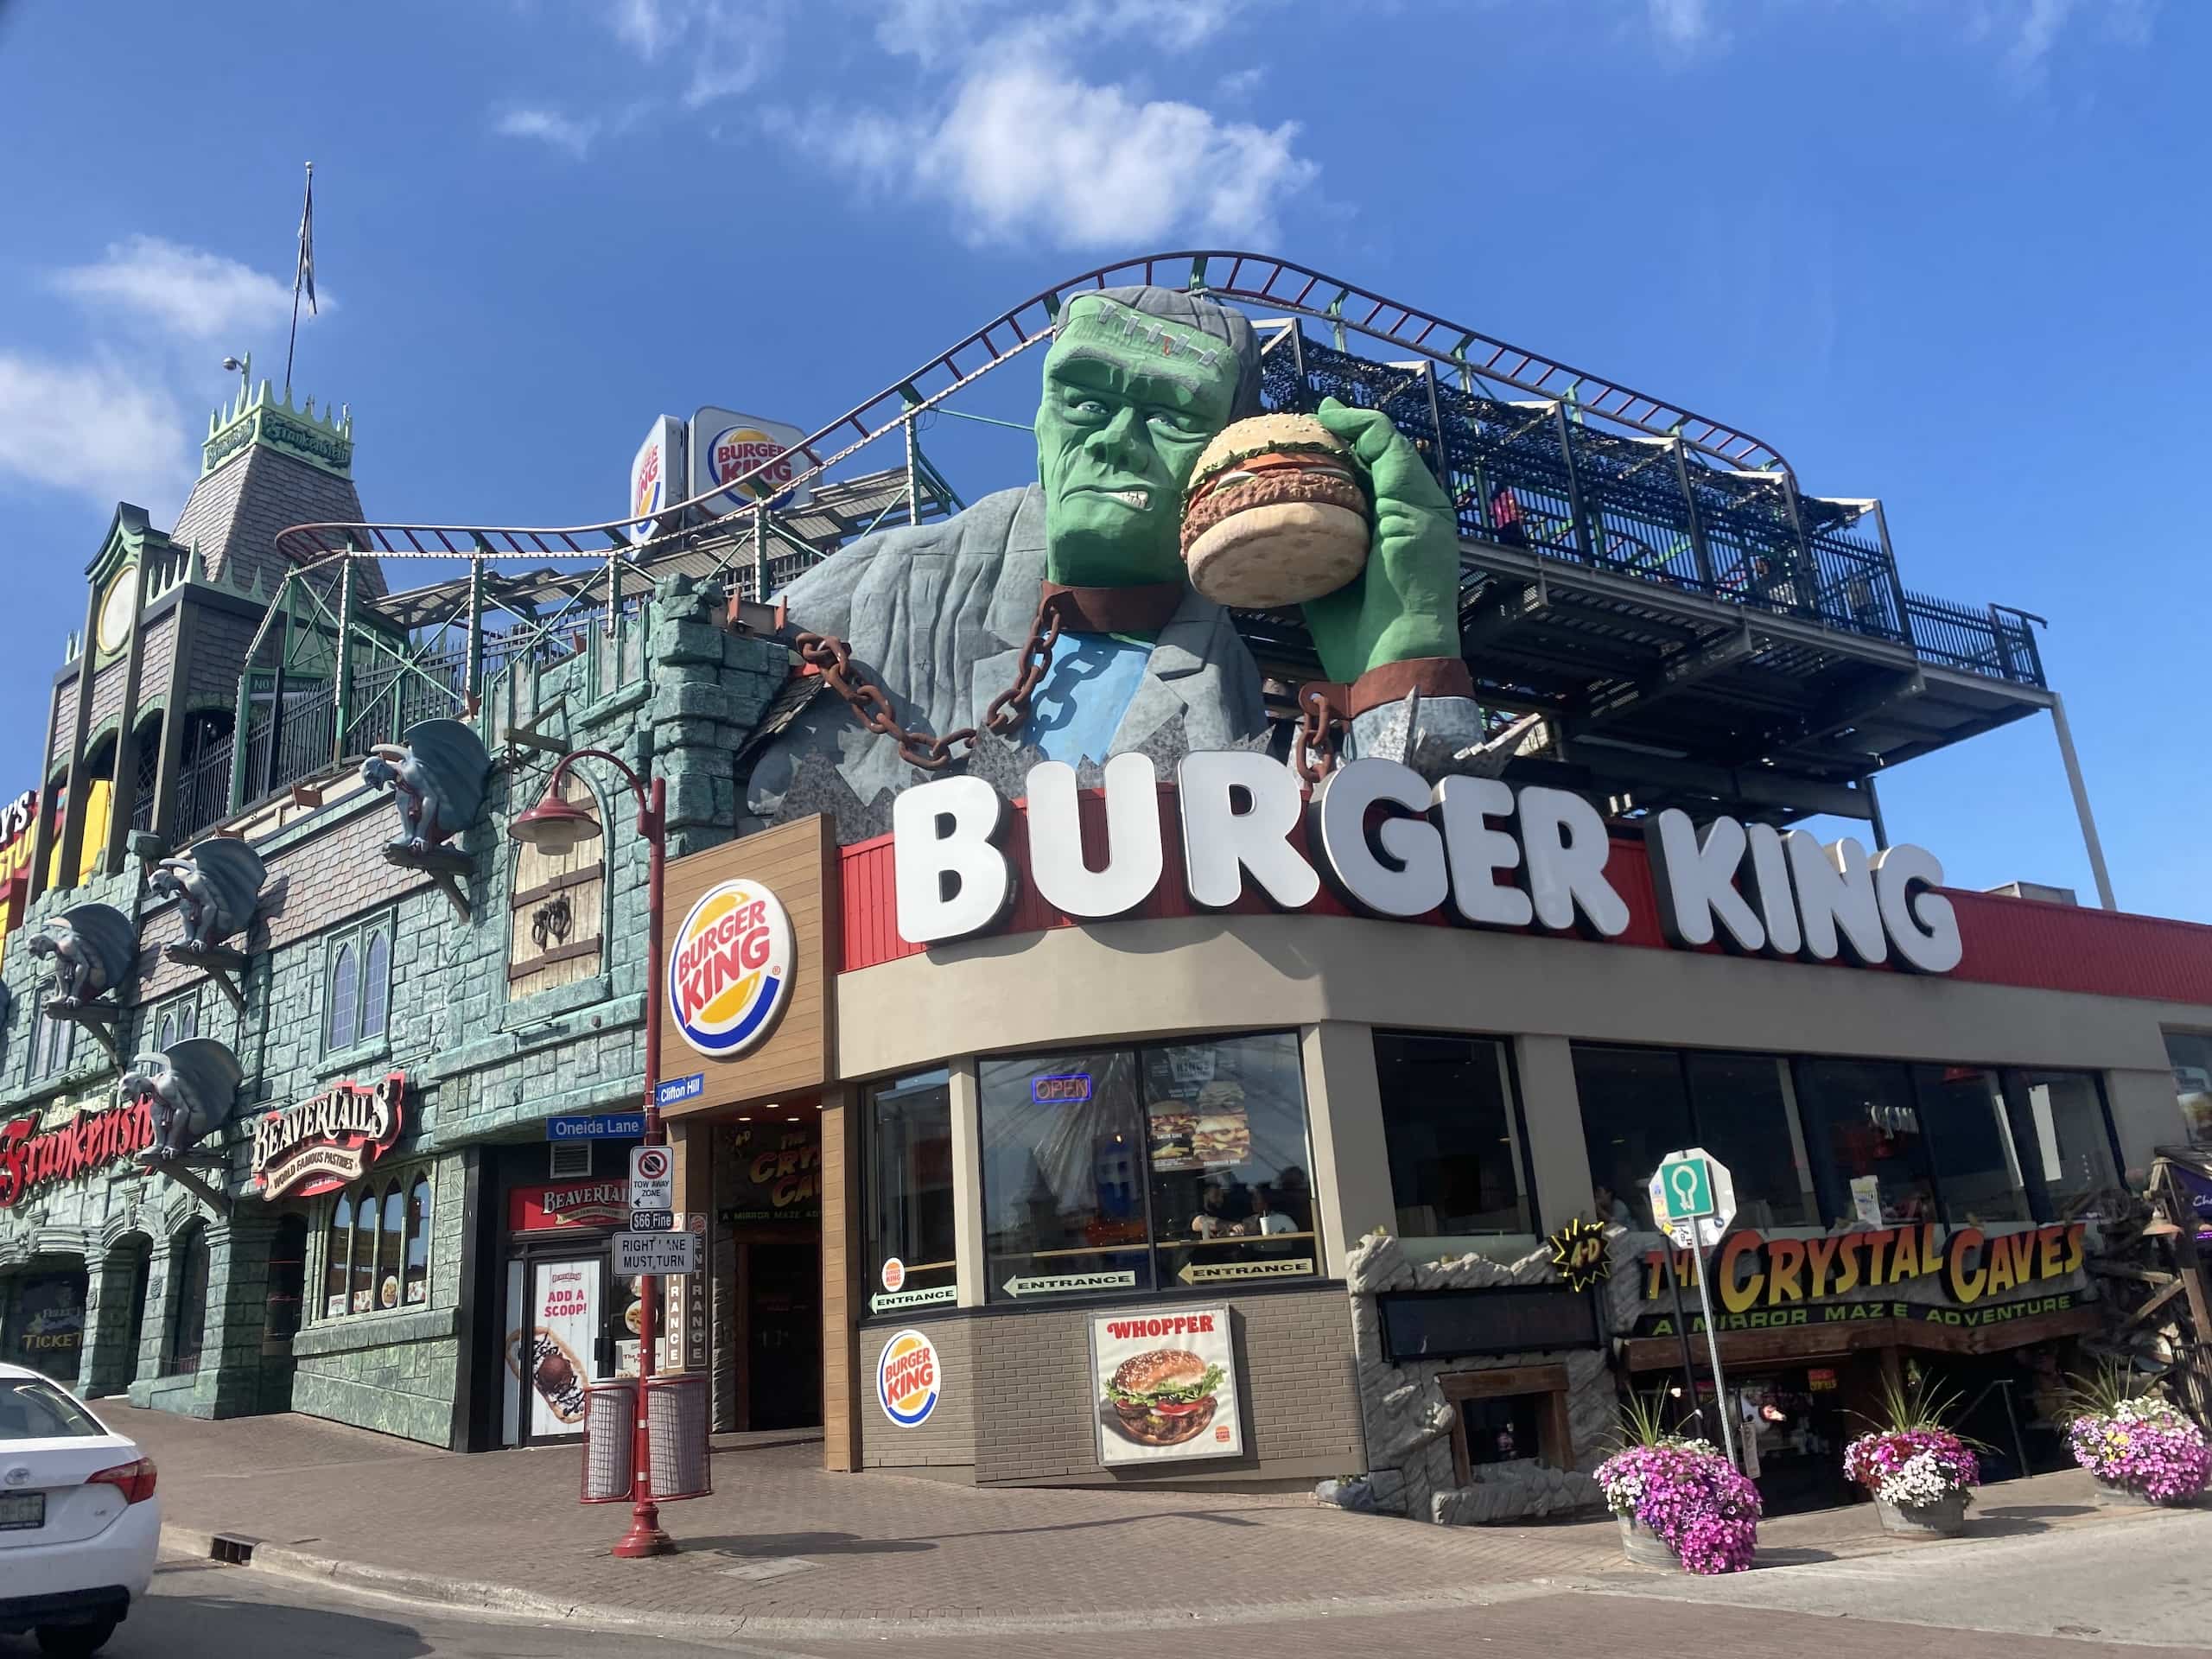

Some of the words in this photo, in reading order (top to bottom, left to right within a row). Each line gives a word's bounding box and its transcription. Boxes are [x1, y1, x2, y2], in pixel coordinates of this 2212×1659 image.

[893, 750, 1630, 944] BURGER
[1656, 808, 1963, 973] KING
[678, 900, 766, 986] BURGER
[682, 926, 771, 1026] KING
[661, 1084, 686, 1103] Clifton
[687, 1079, 700, 1096] Hill
[1036, 1078, 1088, 1099] OPEN
[556, 1121, 604, 1135] Oneida
[607, 1119, 640, 1134] Lane
[274, 1166, 296, 1189] WORLD
[296, 1153, 325, 1172] FAMOUS
[324, 1151, 354, 1170] PASTRIES
[633, 1180, 650, 1189] TOW
[652, 1179, 671, 1188] AWAY
[633, 1214, 651, 1228] $66
[652, 1212, 671, 1228] Fine
[622, 1239, 655, 1252] RIGHT
[658, 1239, 686, 1251] NE
[624, 1255, 655, 1268] MUST
[657, 1255, 684, 1267] TURN
[1192, 1262, 1308, 1278] ENTRANCE
[1719, 1223, 1943, 1313] CRYSTAL
[1948, 1224, 2086, 1303] CAVES
[1017, 1274, 1131, 1290] ENTRANCE
[548, 1290, 572, 1303] ADD
[576, 1289, 585, 1300] A
[877, 1290, 955, 1306] ENTRANCE
[544, 1303, 587, 1317] SCOOP!
[1652, 1319, 1674, 1336] A
[1693, 1309, 1808, 1332] MIRROR
[1926, 1295, 2072, 1327] ADVENTURE
[1106, 1314, 1214, 1339] WHOPPER
[885, 1347, 931, 1384] BURGER
[887, 1363, 934, 1406] KING
